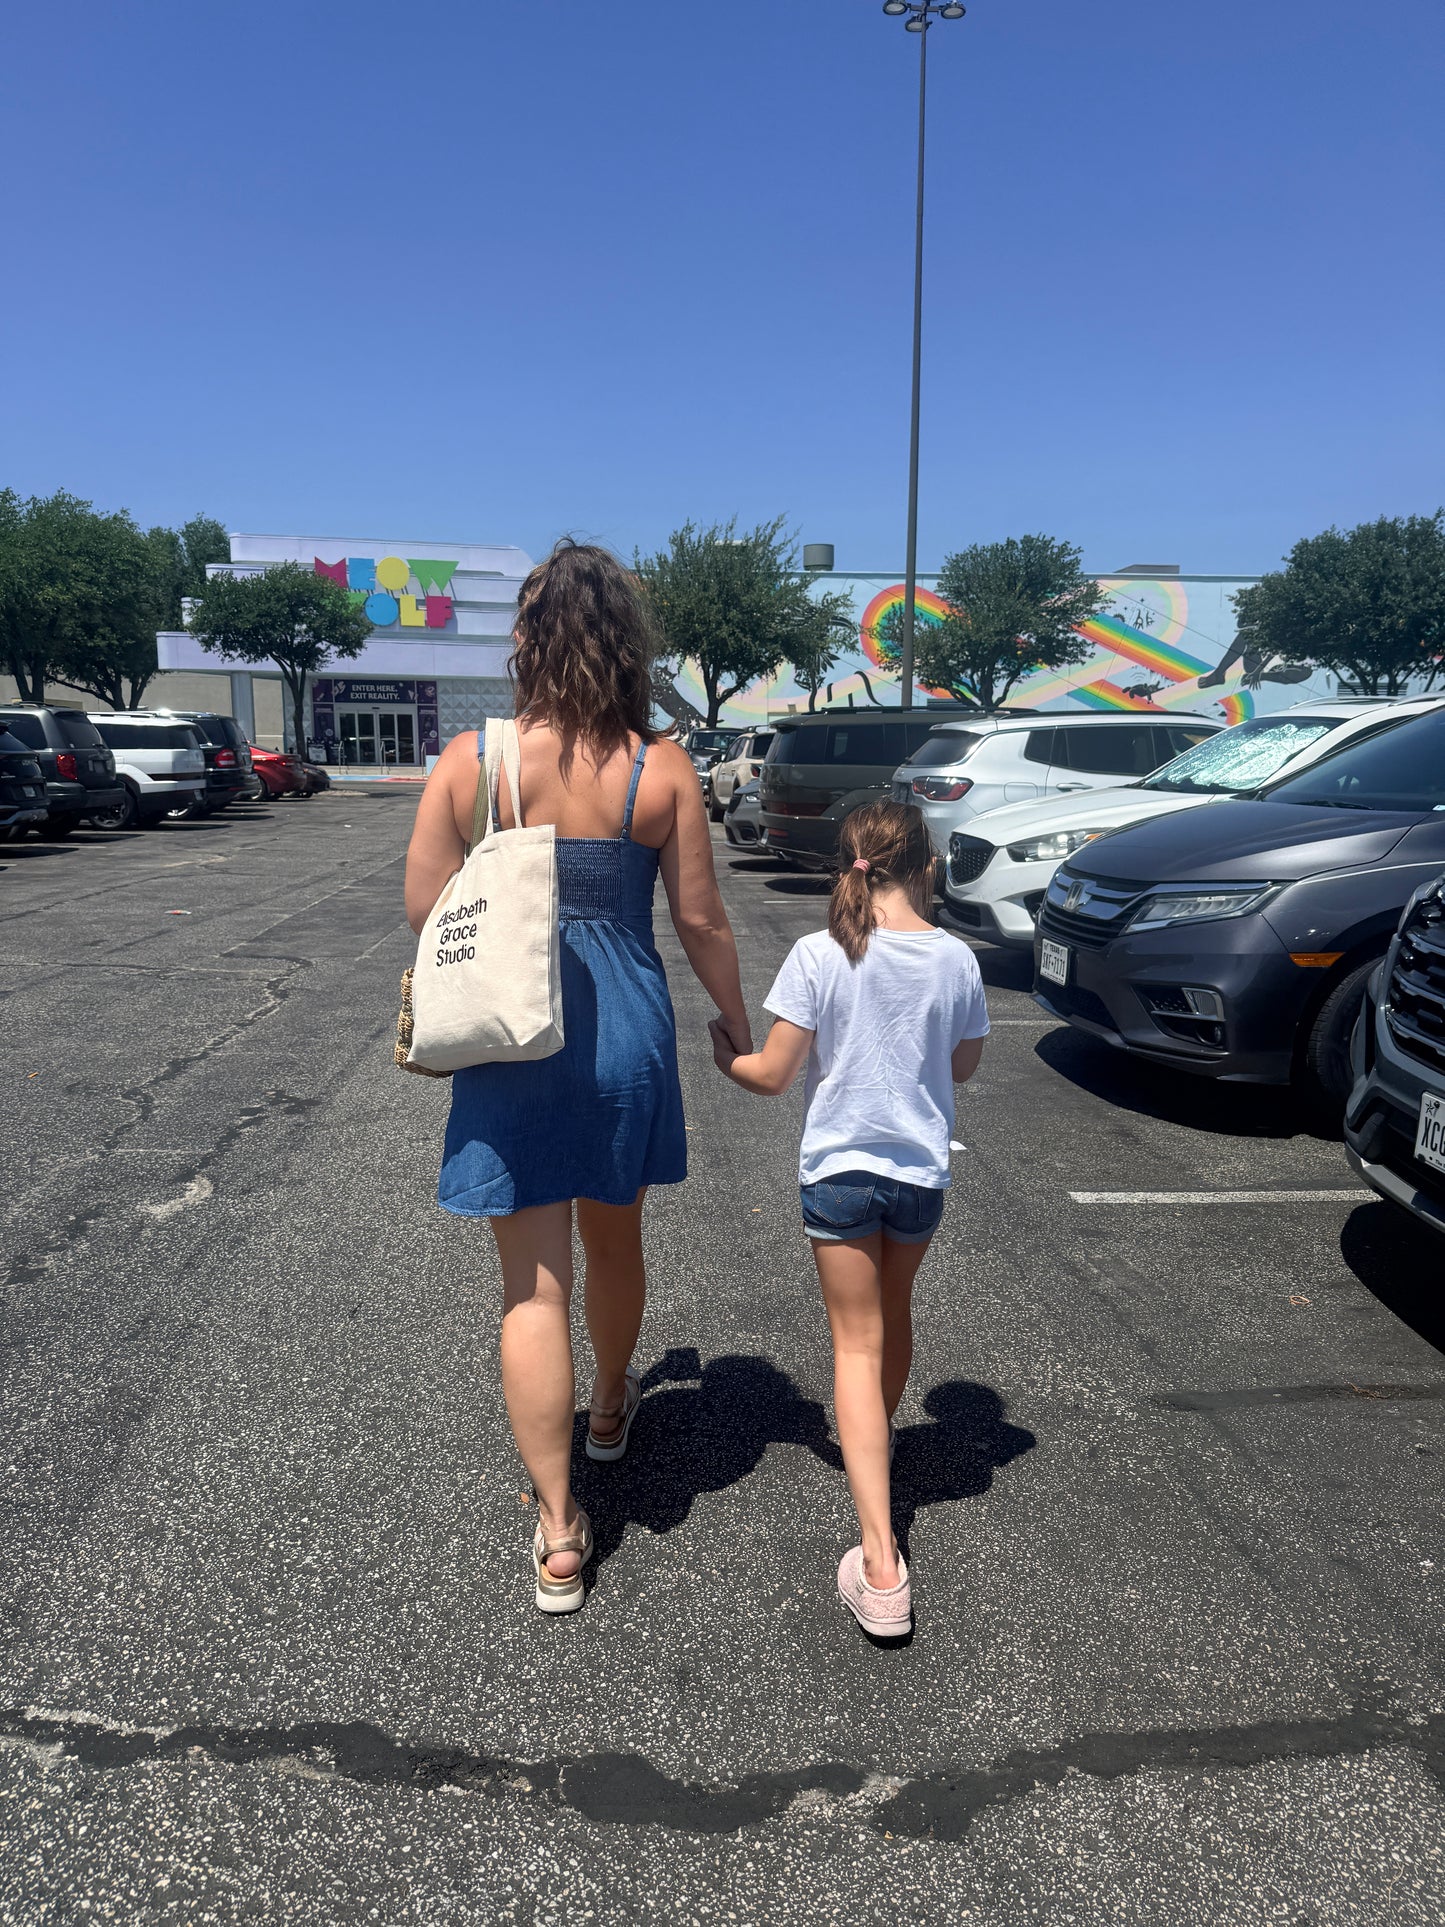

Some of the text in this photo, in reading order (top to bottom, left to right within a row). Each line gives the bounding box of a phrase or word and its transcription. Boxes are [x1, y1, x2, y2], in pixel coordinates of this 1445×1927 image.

[315, 556, 460, 592] MEOW
[350, 692, 400, 700] EXIT REALITY.
[352, 684, 398, 693] ENTER HERE.
[436, 897, 487, 928] Elisabeth
[440, 923, 477, 945] Grace
[436, 943, 475, 967] Studio
